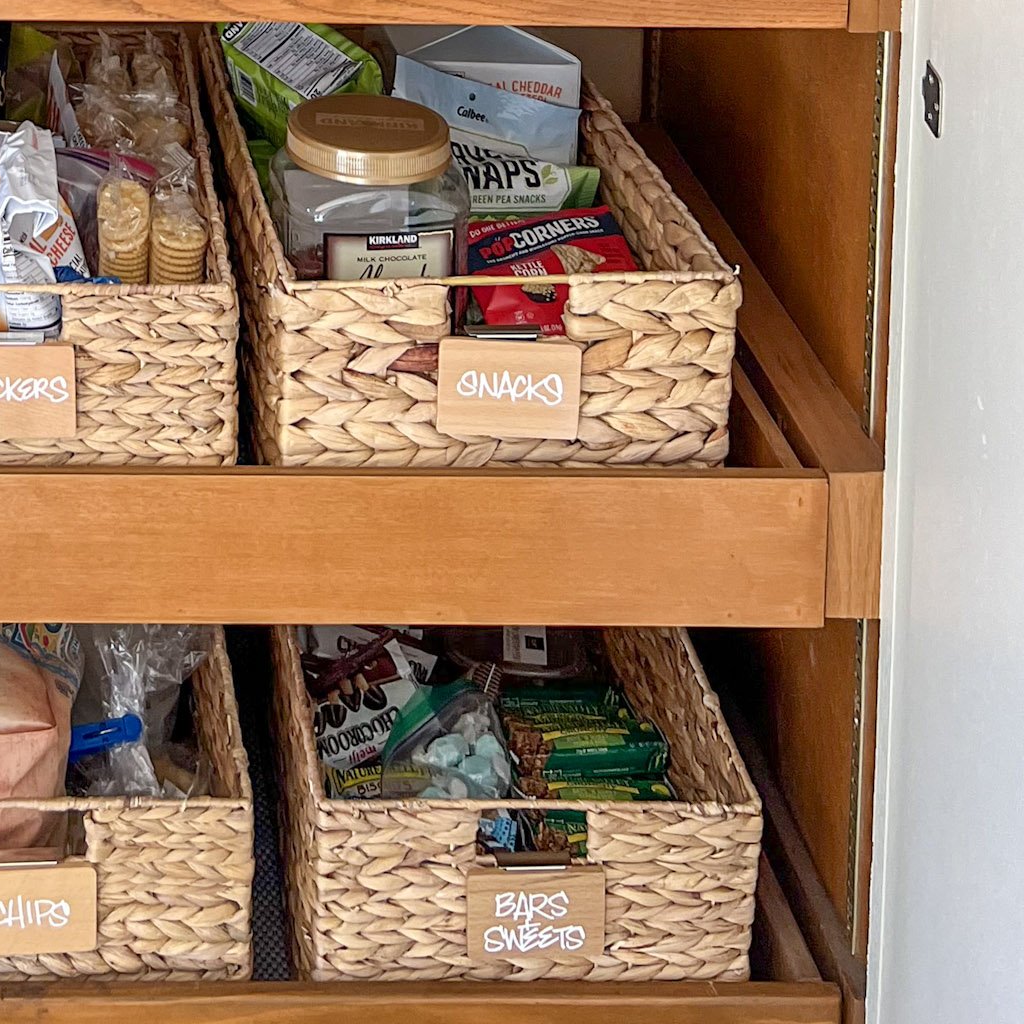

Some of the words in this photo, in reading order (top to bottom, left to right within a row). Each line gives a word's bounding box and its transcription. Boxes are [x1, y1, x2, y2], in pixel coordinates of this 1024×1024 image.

[512, 81, 562, 98] CHEDDAR
[457, 106, 486, 122] Calbee
[462, 159, 541, 189] NAPS
[472, 195, 494, 204] REEN
[496, 195, 511, 204] PEA
[513, 194, 546, 204] SNACKS
[369, 234, 417, 245] KIRKLAND
[469, 228, 481, 238] DO
[46, 223, 76, 267] CHEESE
[379, 254, 427, 262] CHOCOLATE
[510, 259, 544, 270] KETTLE
[456, 370, 563, 406] SNACKS
[350, 745, 377, 764] meiji
[495, 890, 569, 921] BARS
[484, 925, 586, 953] SWEETS
